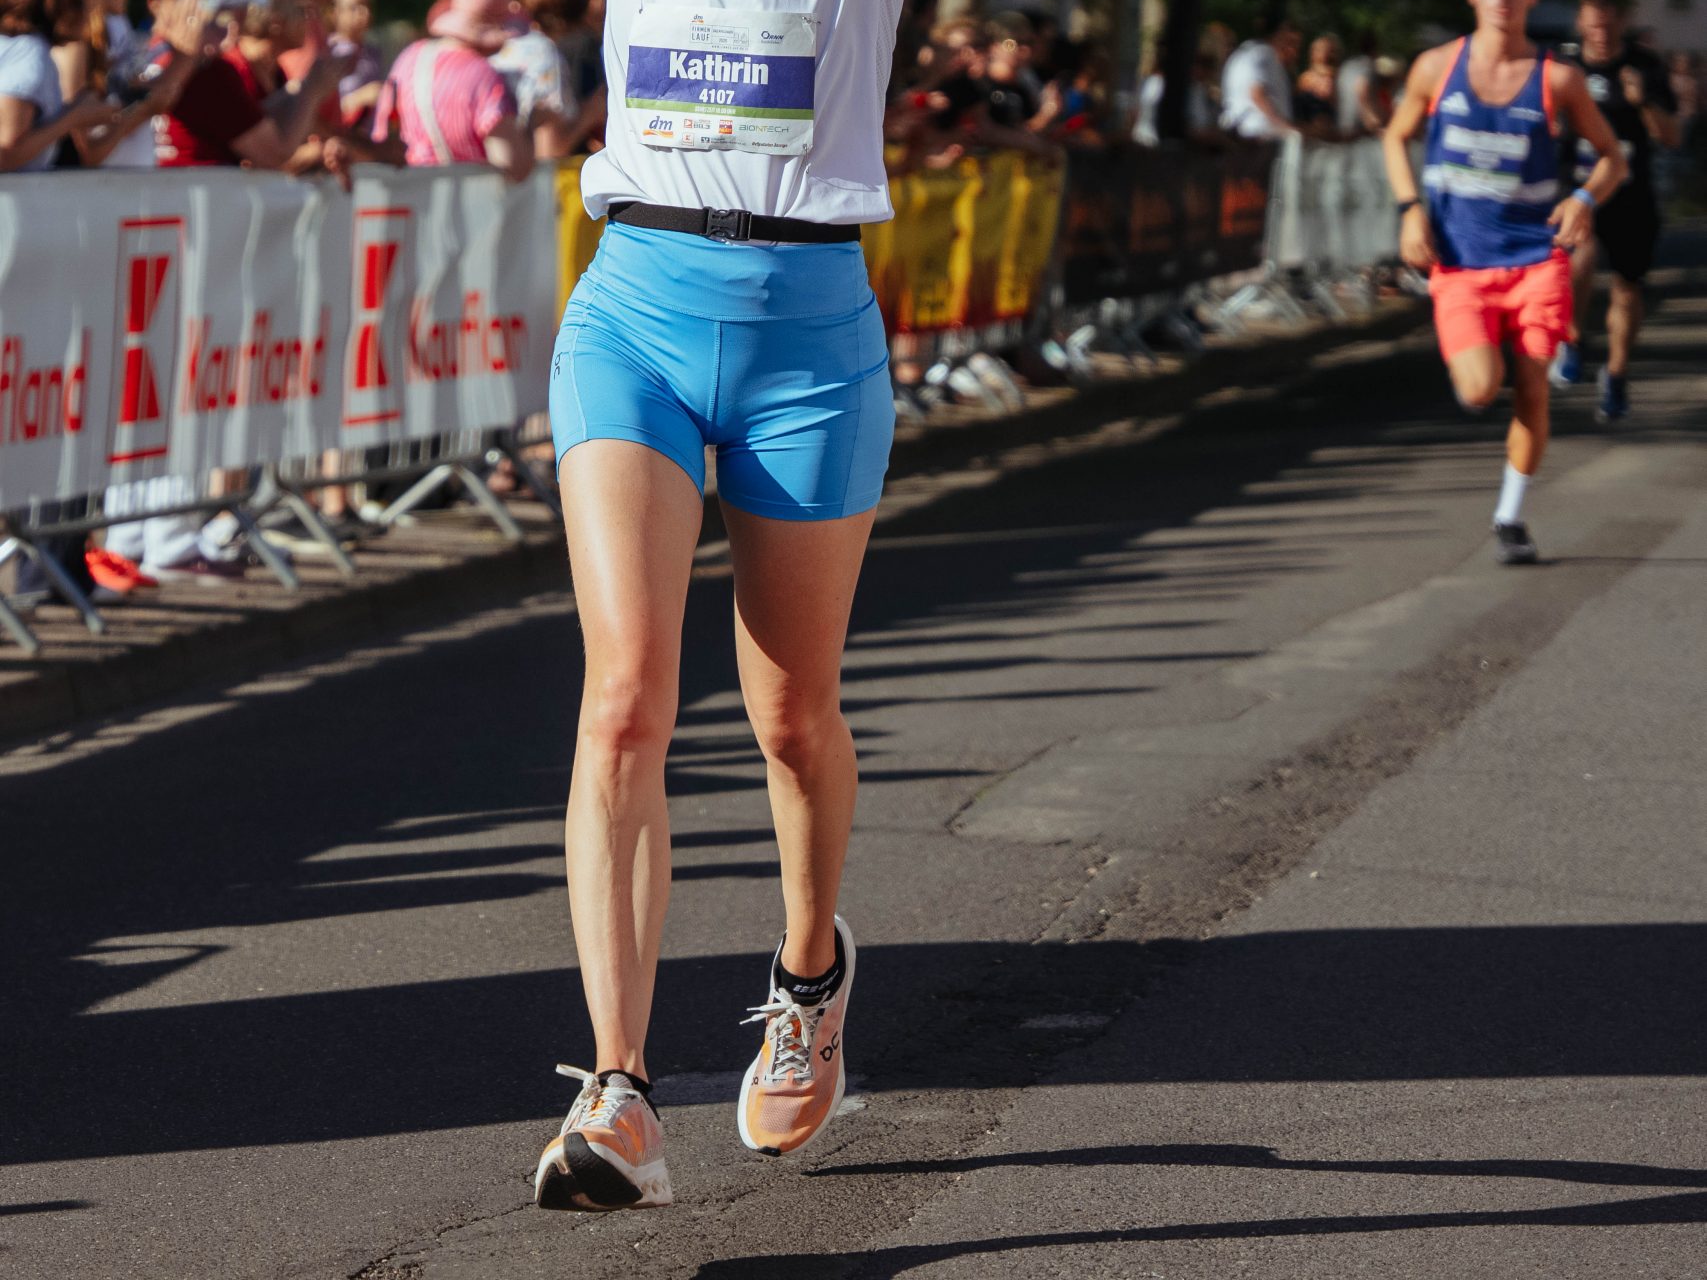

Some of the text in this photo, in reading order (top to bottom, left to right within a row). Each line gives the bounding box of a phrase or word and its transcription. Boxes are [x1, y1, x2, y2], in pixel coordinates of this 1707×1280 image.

[691, 33, 710, 41] LAUF
[669, 51, 769, 85] Kathrin
[699, 88, 735, 105] 4107
[649, 115, 673, 131] dm
[119, 255, 171, 423] K
[180, 305, 330, 417] Kaufland
